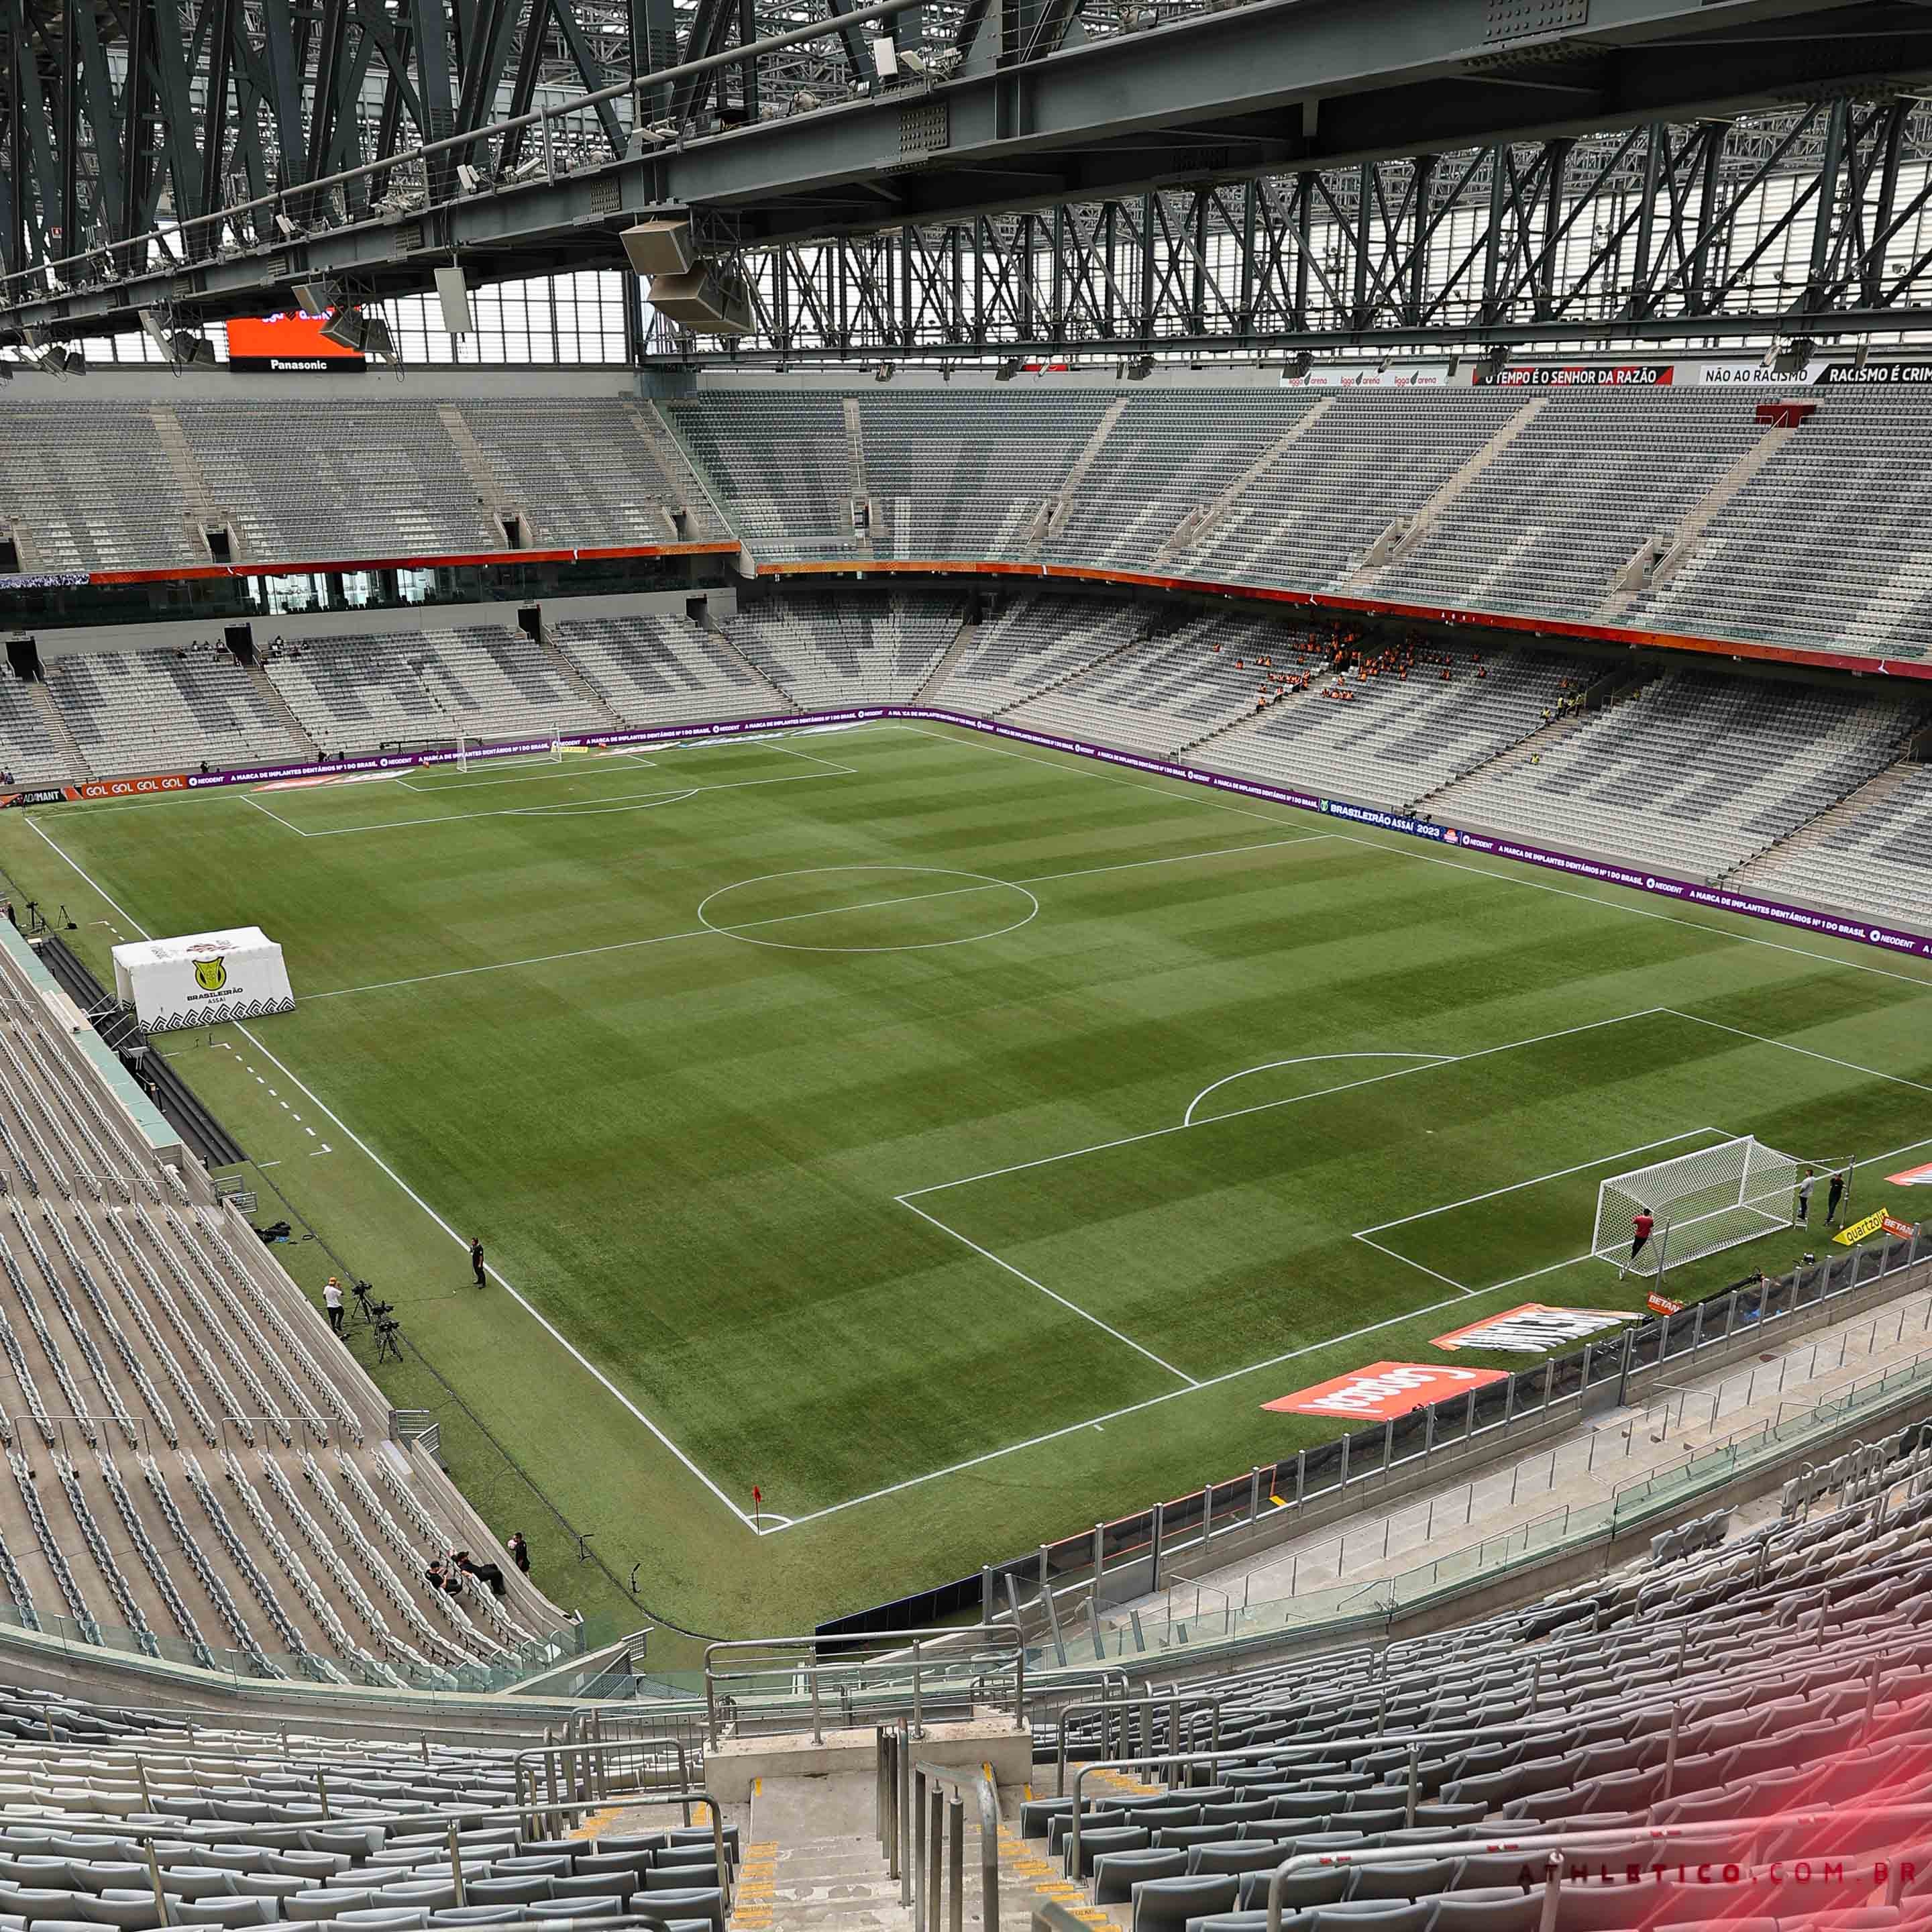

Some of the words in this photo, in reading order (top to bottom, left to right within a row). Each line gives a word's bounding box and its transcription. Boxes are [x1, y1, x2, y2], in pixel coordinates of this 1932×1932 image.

[270, 359, 327, 370] Panasonic
[1497, 371, 1530, 384] TEMPO
[1532, 368, 1540, 384] É
[1541, 371, 1549, 384] O
[1550, 370, 1596, 384] SENHOR
[1598, 370, 1614, 384] DA
[1616, 366, 1657, 384] RAZÃO
[1706, 367, 1731, 382] NÃO
[1733, 370, 1750, 382] AO
[1754, 370, 1808, 382] RACISMO
[1829, 368, 1888, 382] RACISMO
[1890, 364, 1900, 381] É
[86, 786, 108, 797] GOL
[111, 783, 133, 794] GOL
[137, 780, 158, 791] GOL
[161, 777, 183, 789] GOL
[1331, 804, 1391, 825] BRASILEIRÃO
[1391, 818, 1413, 830] ASSAÍ
[1417, 824, 1440, 837] 2023
[1470, 839, 1493, 849] NEODENT
[1655, 882, 1684, 894] NEODENT
[1880, 935, 1915, 948] NEODENT
[187, 987, 243, 1001] BRASILEIRÃO
[1884, 1218, 1915, 1236] BETAN
[1649, 1295, 1681, 1313] BETAN
